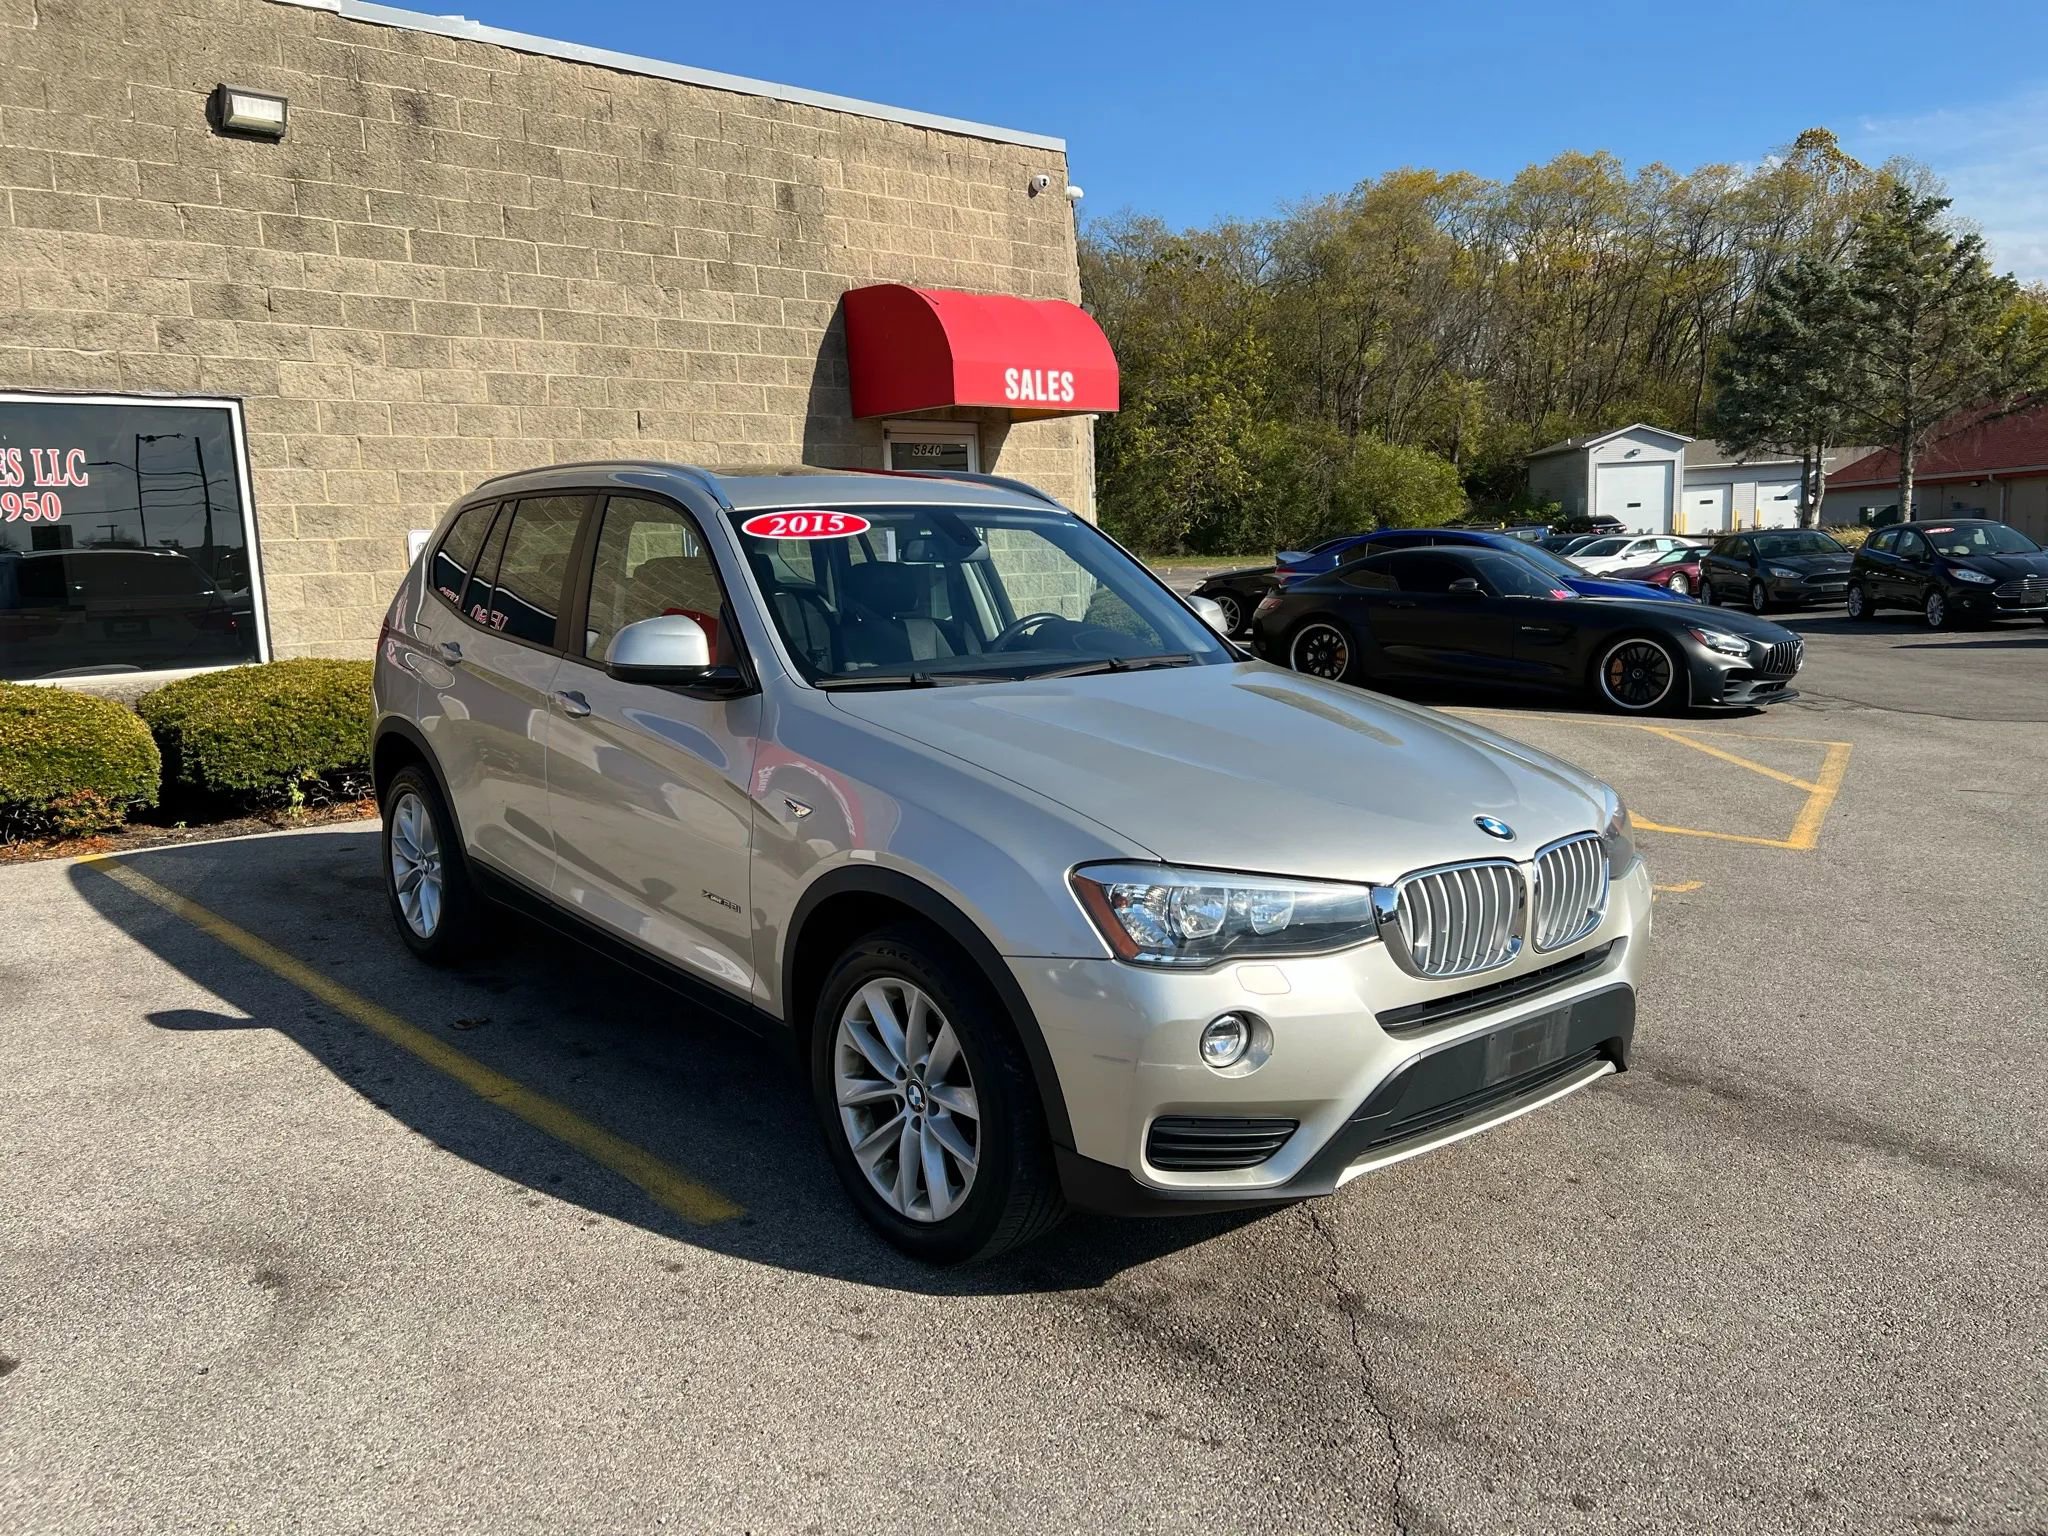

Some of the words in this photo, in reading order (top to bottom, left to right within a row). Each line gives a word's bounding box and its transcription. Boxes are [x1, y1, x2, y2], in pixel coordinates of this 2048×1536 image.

[1005, 367, 1075, 403] SALES
[913, 443, 941, 456] 5840
[30, 448, 89, 487] LLC
[0, 491, 62, 523] 950
[768, 515, 845, 536] 2015
